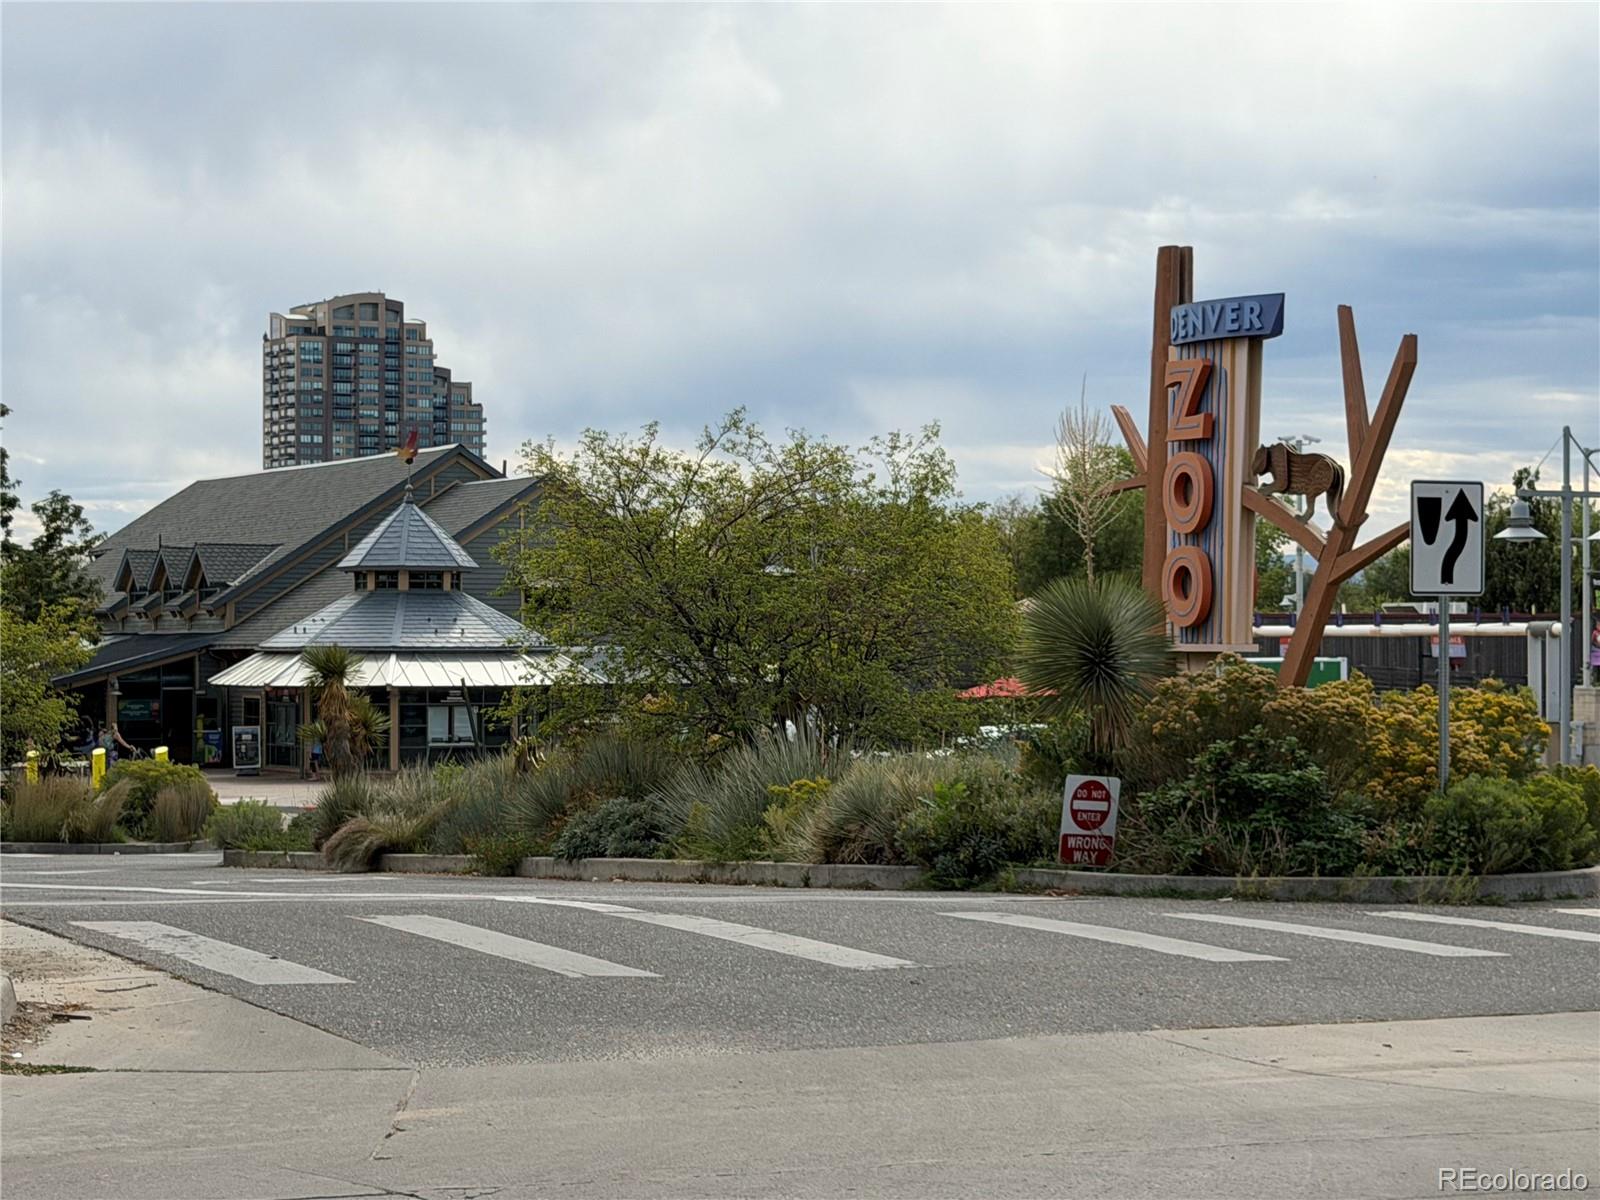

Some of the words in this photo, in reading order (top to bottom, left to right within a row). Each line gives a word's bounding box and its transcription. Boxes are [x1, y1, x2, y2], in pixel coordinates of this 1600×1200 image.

[1171, 300, 1264, 342] DENVER
[1161, 358, 1214, 628] ZOO
[1077, 789, 1088, 798] DO
[1091, 790, 1106, 799] NOT
[1077, 812, 1102, 821] ENTER
[1067, 836, 1106, 850] WRONG
[1073, 850, 1098, 863] WAY
